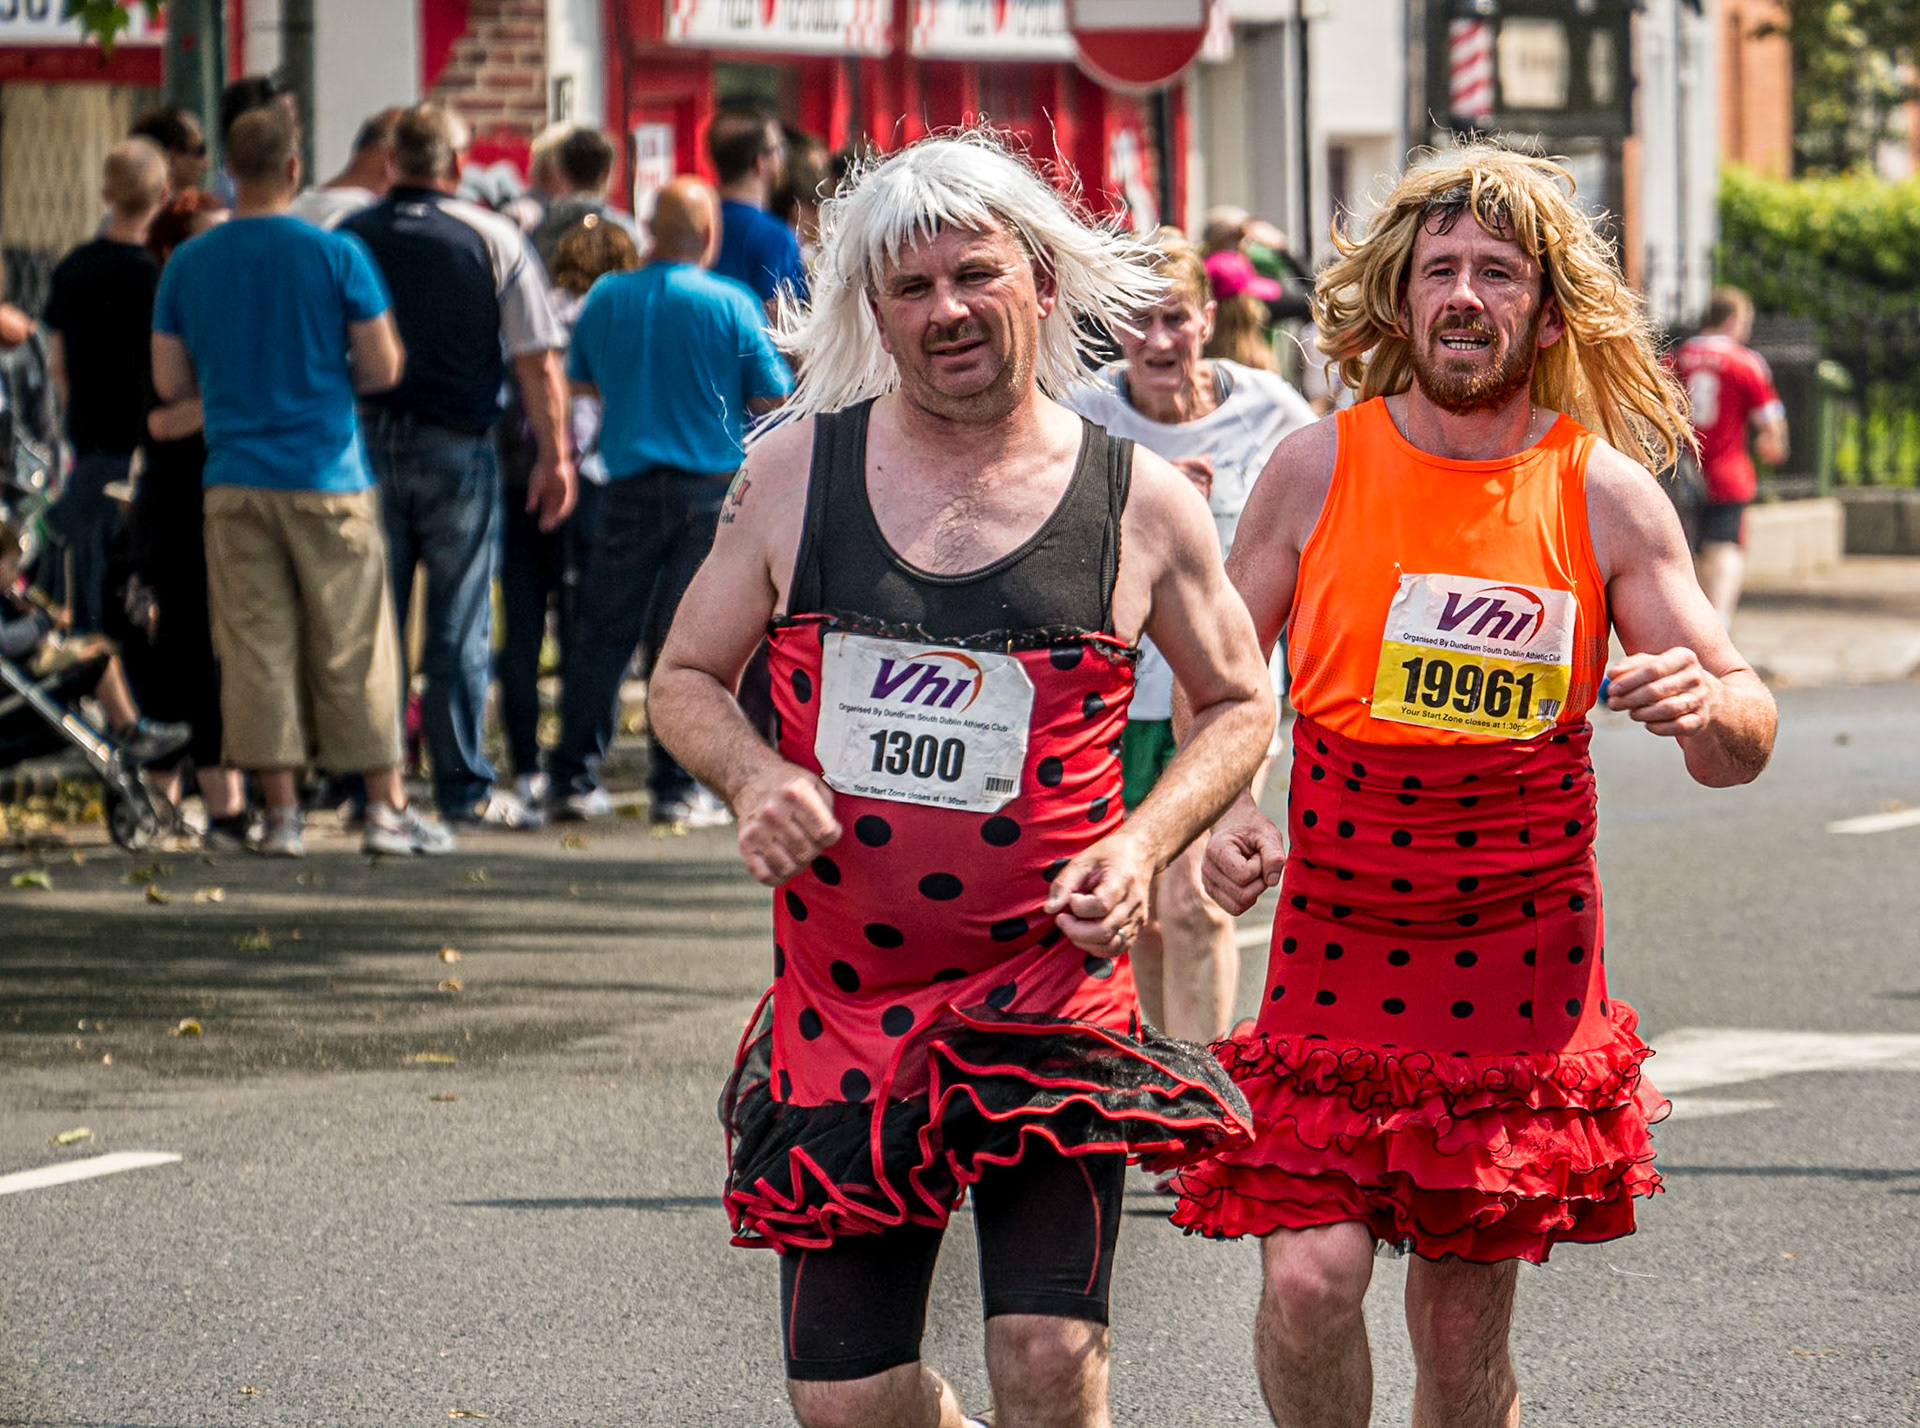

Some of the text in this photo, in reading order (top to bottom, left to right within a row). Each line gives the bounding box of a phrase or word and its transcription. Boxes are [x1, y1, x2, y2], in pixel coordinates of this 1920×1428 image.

[1436, 592, 1535, 641] Vhi
[1403, 632, 1561, 662] Organised By Dundrum South Dublin Athletic Club
[870, 658, 971, 708] Vhi
[1402, 656, 1534, 720] 19961
[838, 702, 1009, 732] Organised By Dundrum South Dublin Athletic Club
[1401, 706, 1527, 732] Your Start Zone closes at 1:30p
[870, 729, 966, 782] 1300
[854, 784, 967, 806] Your Start Zone closes at 1:30pm
